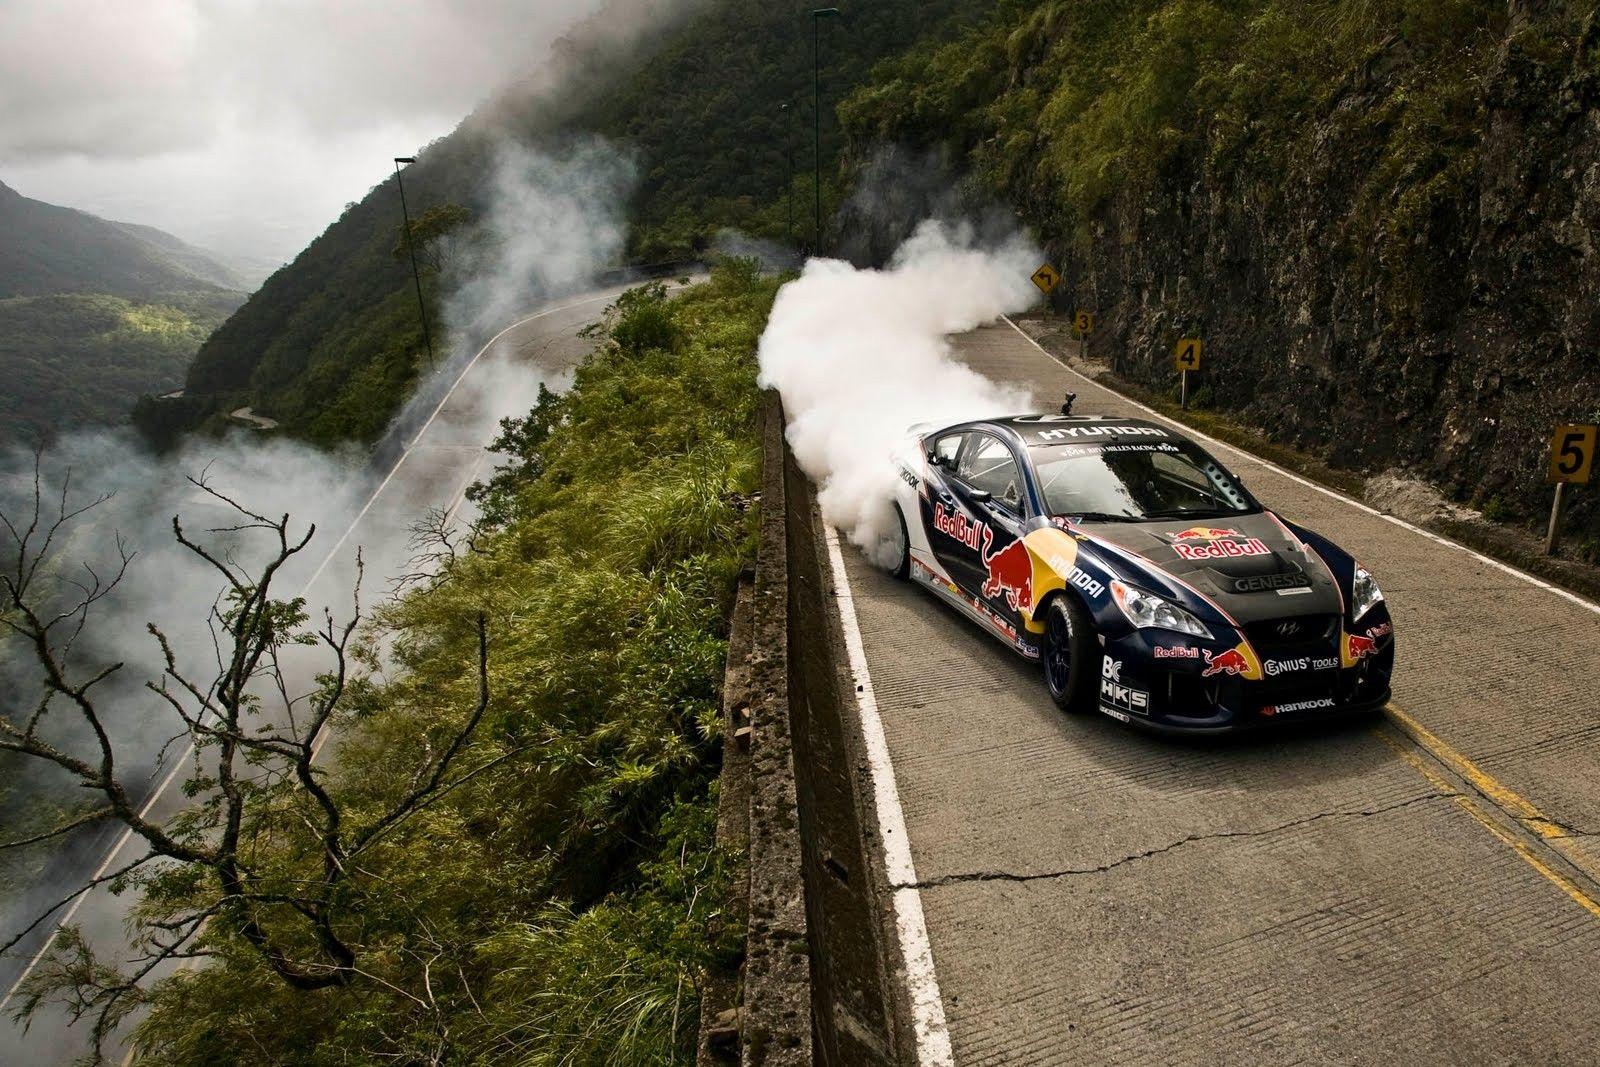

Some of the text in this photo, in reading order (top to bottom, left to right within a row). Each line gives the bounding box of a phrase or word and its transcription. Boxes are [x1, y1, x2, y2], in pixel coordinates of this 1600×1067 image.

[1079, 314, 1089, 330] 3
[1180, 344, 1196, 366] 4
[1038, 426, 1169, 441] HYUNDAI
[1558, 433, 1585, 475] 5
[1234, 575, 1308, 592] GENESIS
[1312, 657, 1339, 669] TOOLS
[1102, 679, 1147, 707] HKS
